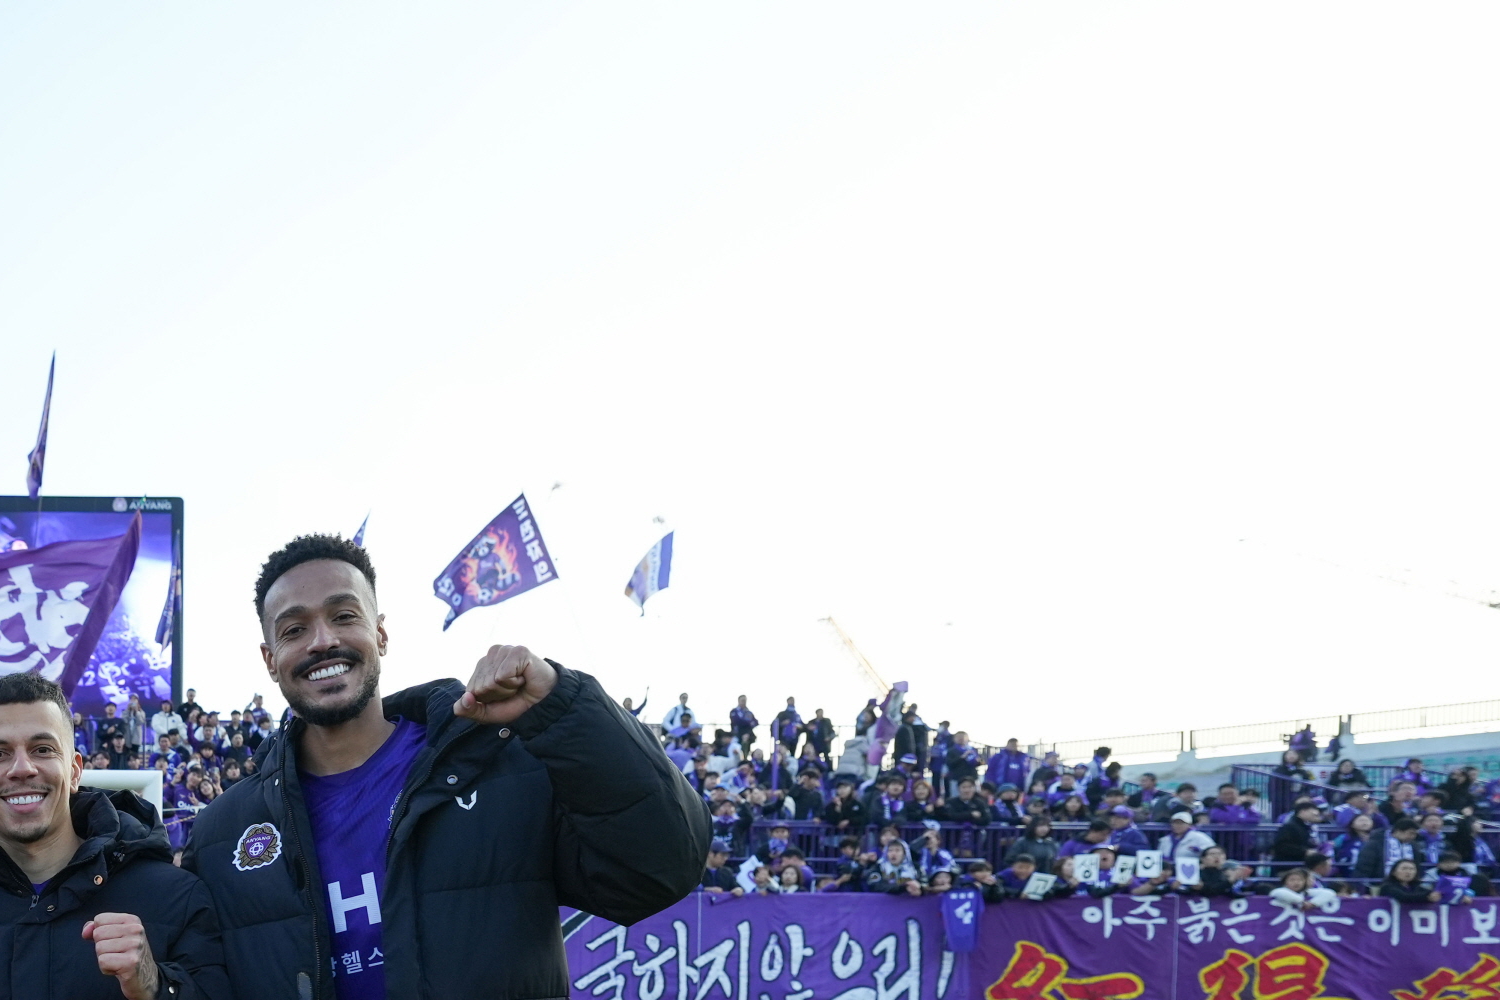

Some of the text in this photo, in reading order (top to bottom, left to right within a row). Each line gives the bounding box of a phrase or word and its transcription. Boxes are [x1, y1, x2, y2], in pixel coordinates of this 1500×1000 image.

[246, 835, 271, 844] ANYANG
[1082, 895, 1168, 941] 아주
[1176, 897, 1262, 944] 붉은
[1367, 897, 1450, 947] 이미
